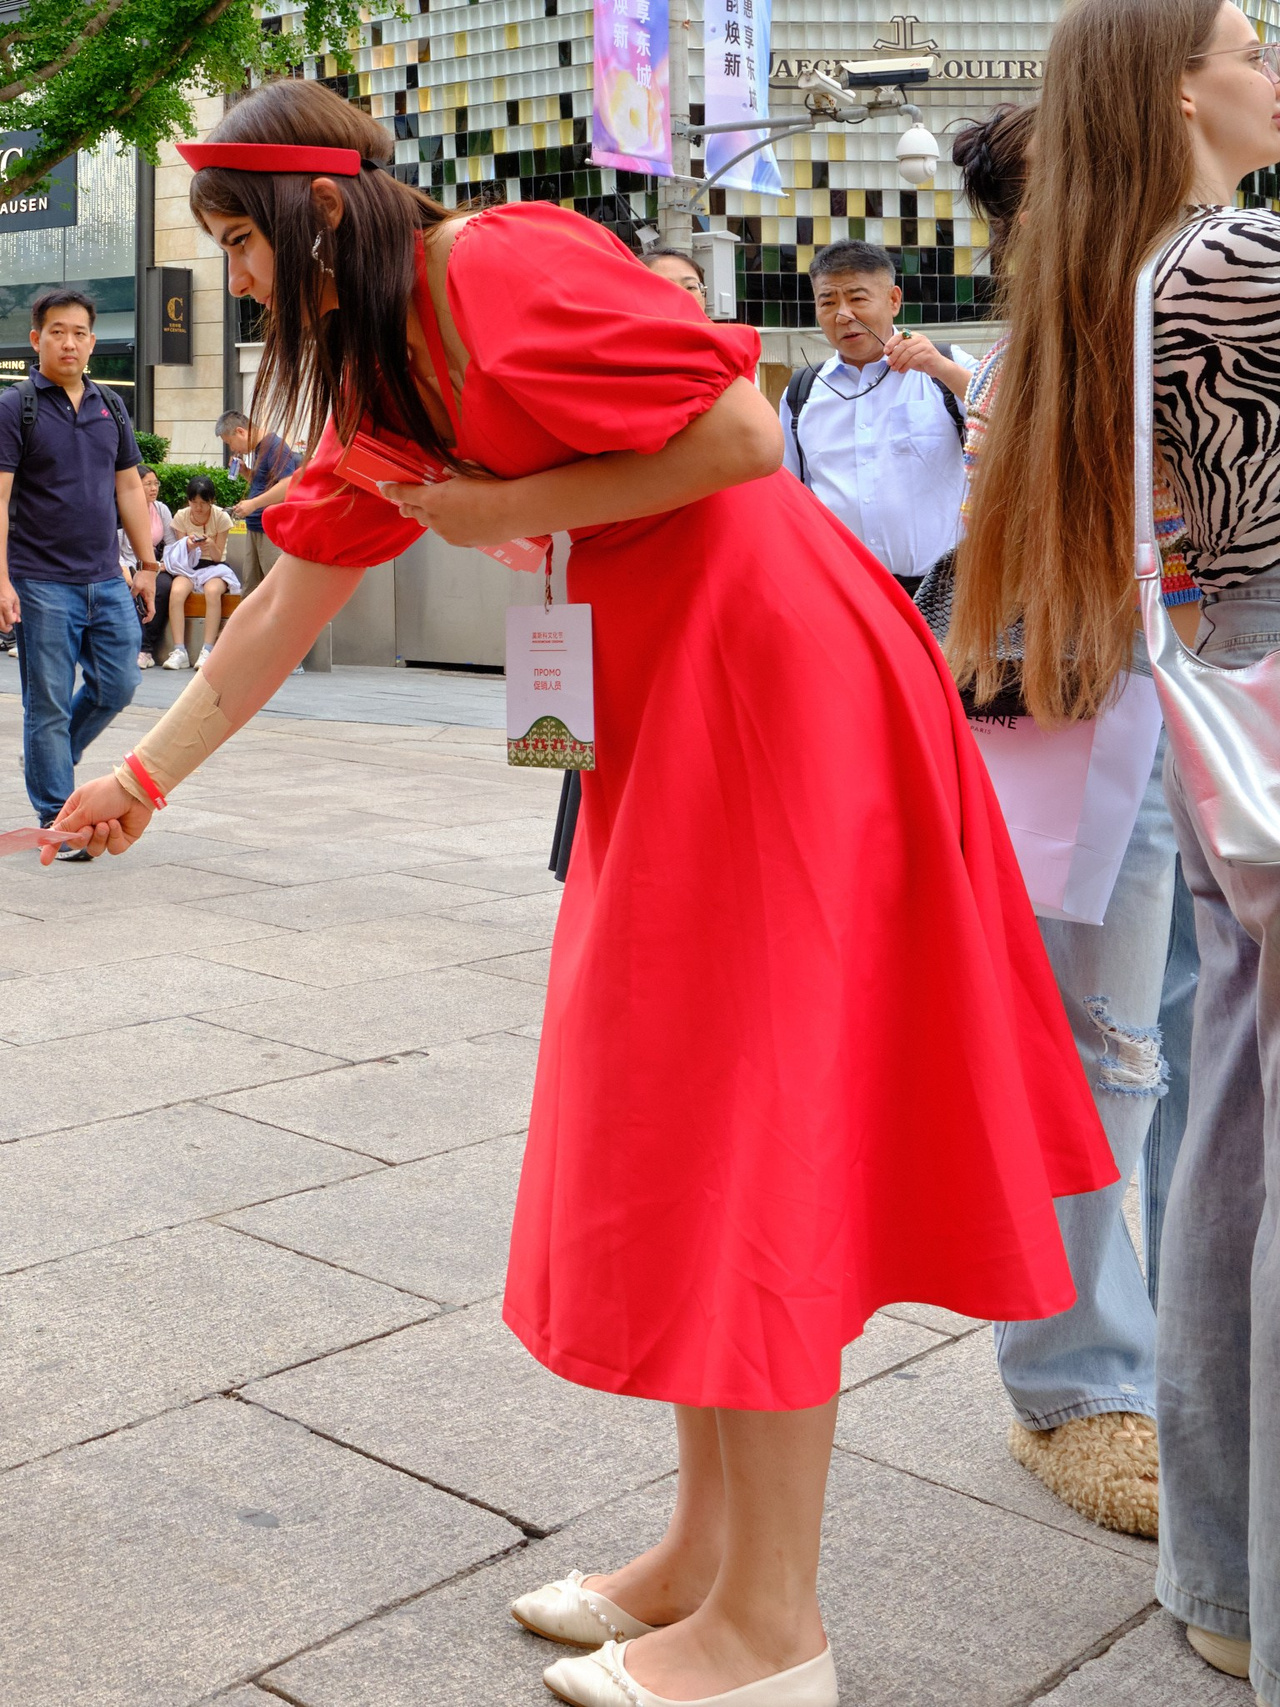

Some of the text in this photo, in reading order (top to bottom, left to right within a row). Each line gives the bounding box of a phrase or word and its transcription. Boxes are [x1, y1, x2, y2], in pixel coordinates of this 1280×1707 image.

[533, 668, 562, 678] ПРОМО
[533, 681, 562, 691] 促销人员
[970, 725, 992, 735] PARIS
